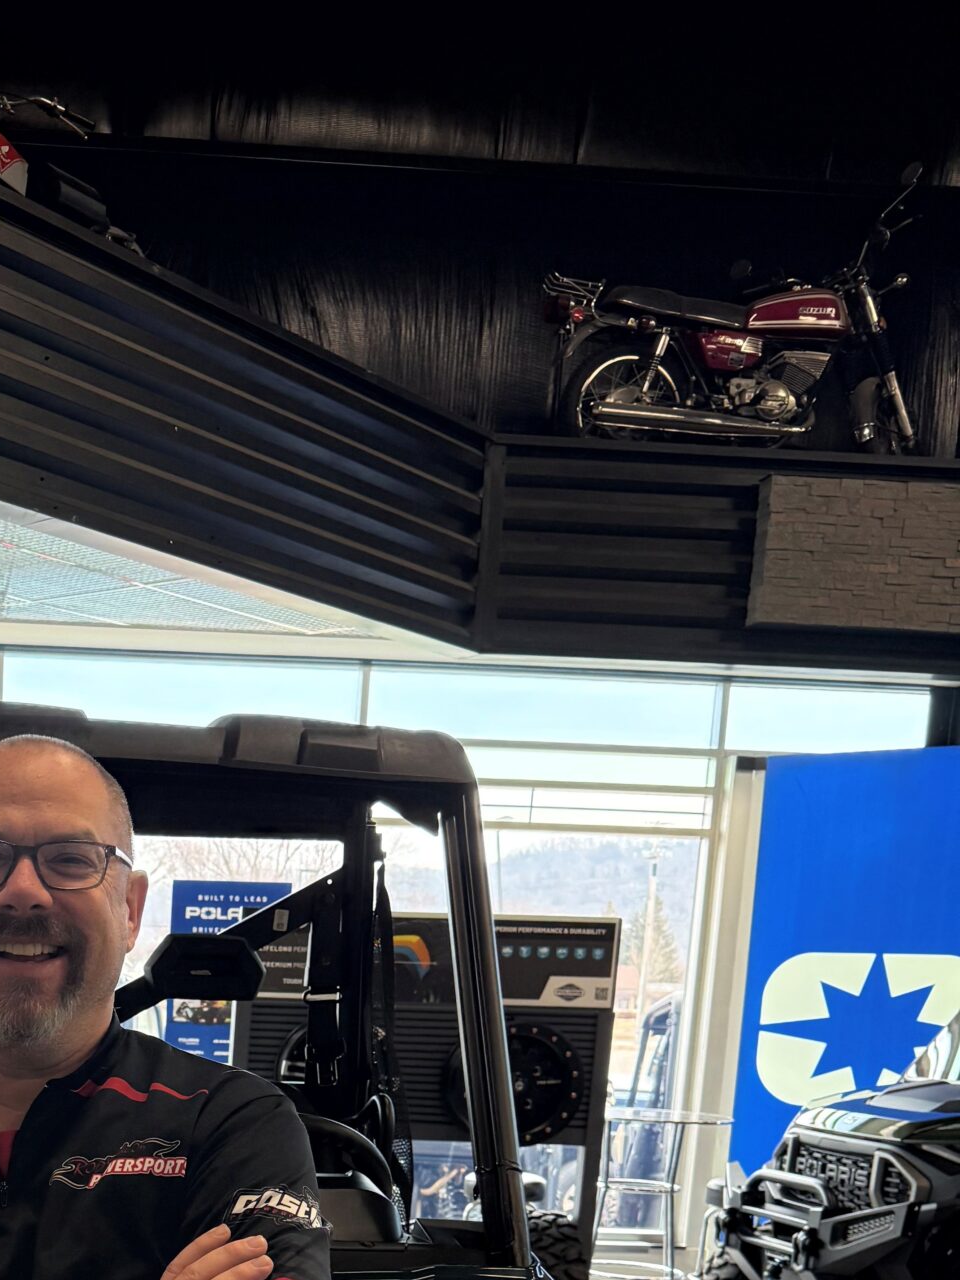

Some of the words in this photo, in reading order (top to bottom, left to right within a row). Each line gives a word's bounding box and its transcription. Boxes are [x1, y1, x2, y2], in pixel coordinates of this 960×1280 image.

[185, 906, 240, 920] POLA
[518, 927, 563, 935] PERFORMANCE
[570, 928, 607, 936] DURABILITY
[796, 1157, 868, 1188] POLARIS
